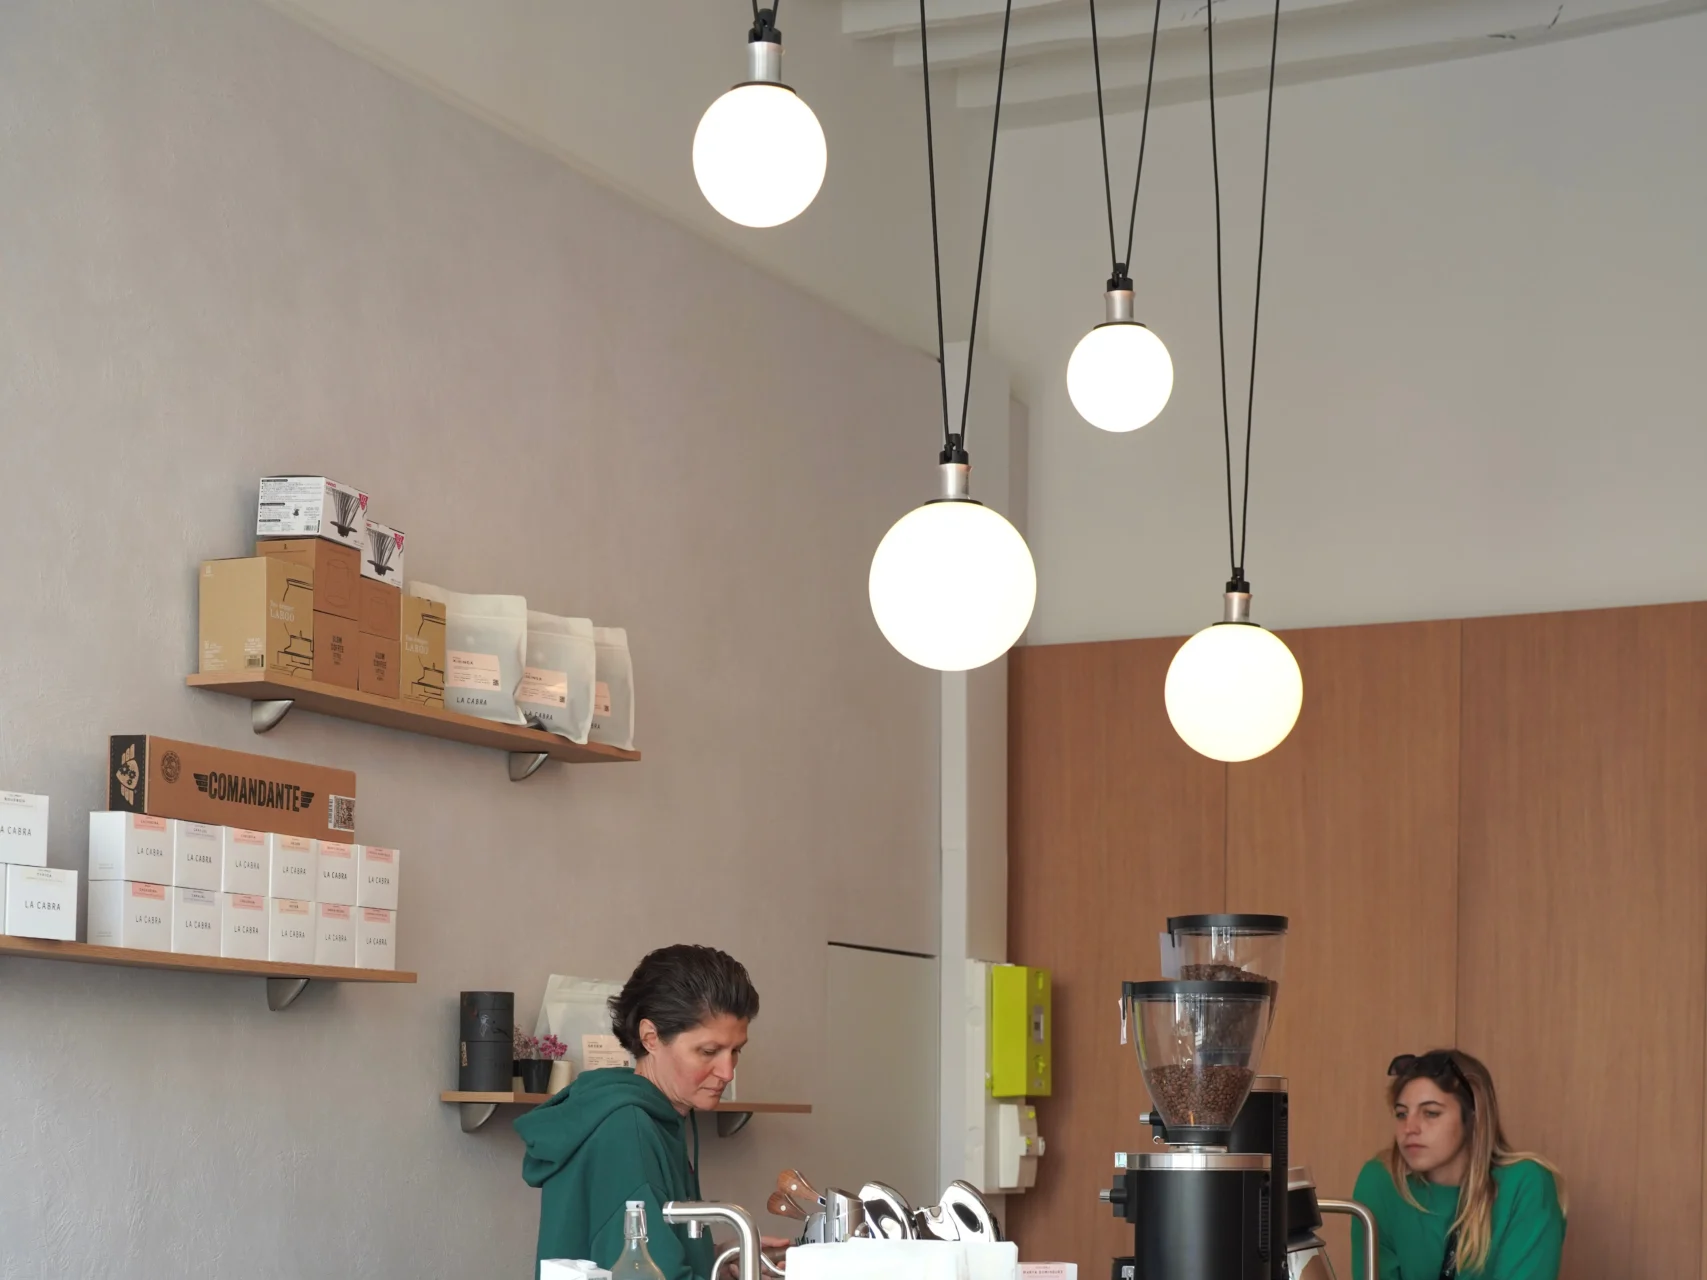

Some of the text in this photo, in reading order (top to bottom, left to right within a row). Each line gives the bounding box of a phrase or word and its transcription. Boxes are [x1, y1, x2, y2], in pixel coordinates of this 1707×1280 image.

[467, 697, 487, 705] CABRA
[534, 711, 553, 720] CABRA
[207, 771, 300, 812] COMANDANTE
[7, 826, 32, 836] CABRA
[137, 847, 163, 857] LA CABRA
[187, 853, 212, 864] LA CABRA
[235, 860, 260, 870] LA CABRA
[283, 865, 306, 875] LA CABRA
[332, 871, 347, 880] CABRA
[375, 877, 390, 885] CABRA
[25, 900, 61, 911] LA CABRA
[136, 915, 161, 925] LA CABRA
[185, 920, 211, 930] LA CABRA
[234, 925, 259, 934] LA CABRA
[289, 930, 305, 939] CABRA
[332, 934, 347, 942] CABRA
[366, 937, 387, 946] LA CABRA
